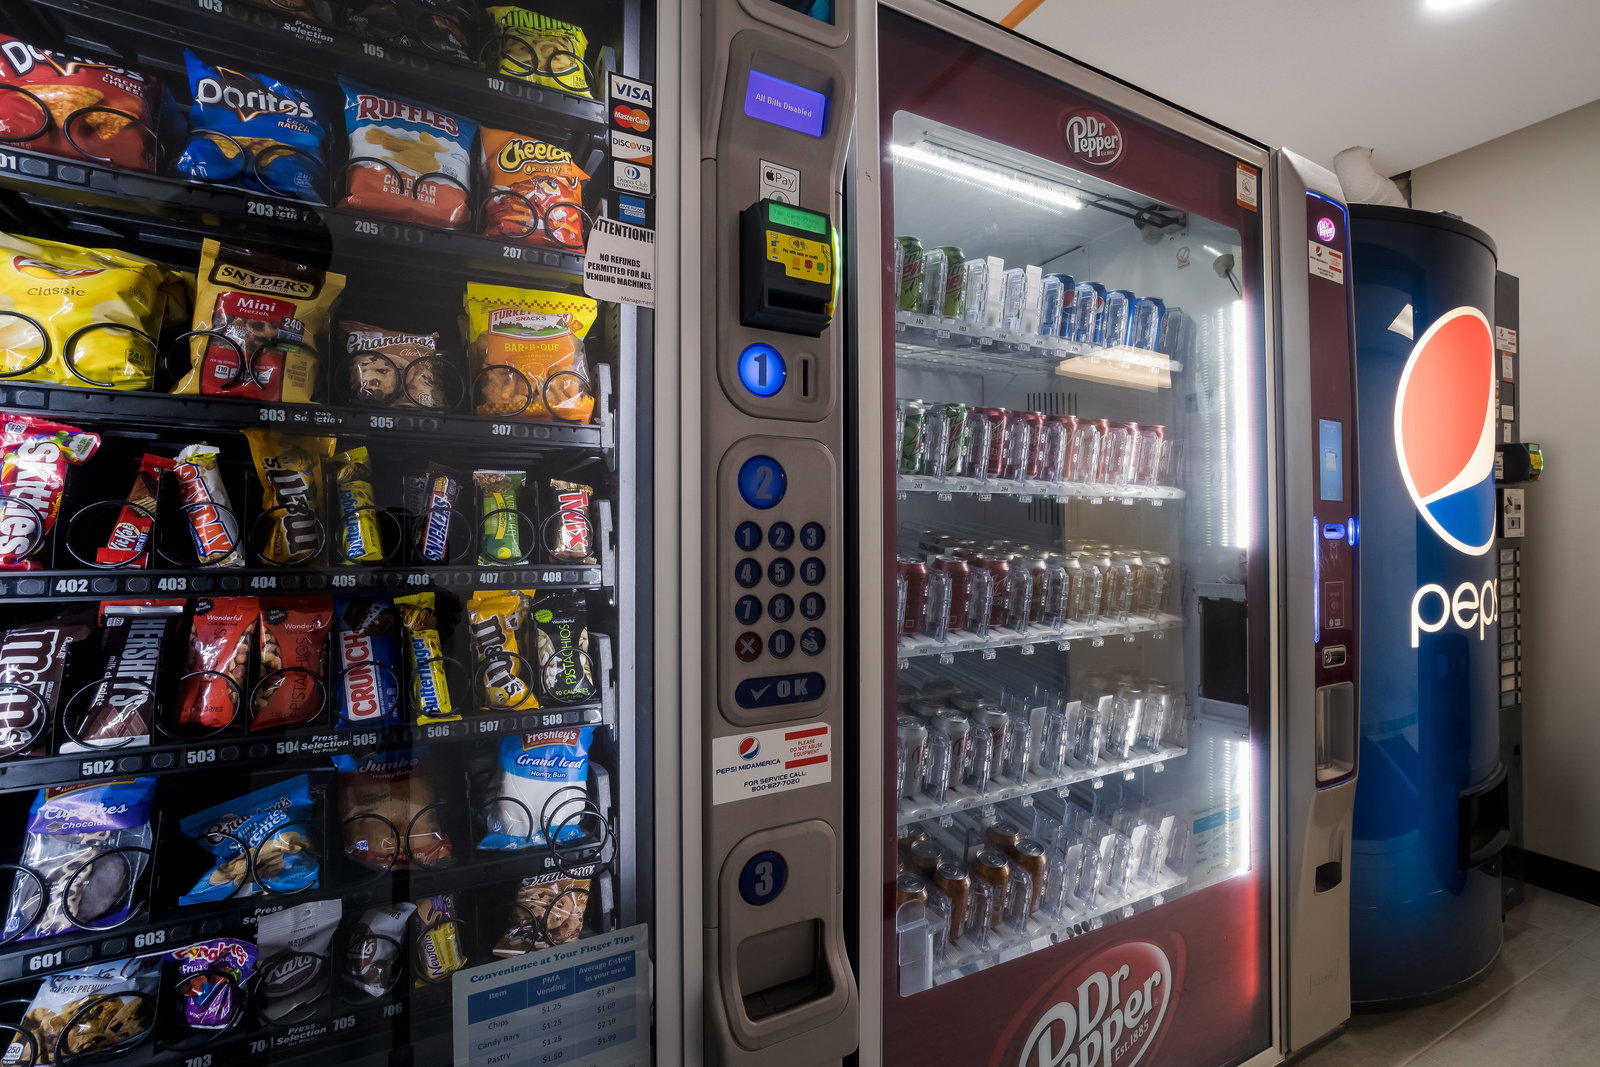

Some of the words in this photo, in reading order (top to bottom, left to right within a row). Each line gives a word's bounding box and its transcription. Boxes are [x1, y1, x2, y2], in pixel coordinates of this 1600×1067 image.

[283, 22, 333, 42] Selection
[294, 20, 322, 33] Press
[305, 36, 322, 44] Price
[362, 42, 384, 58] 105
[487, 77, 505, 91] 107
[614, 80, 651, 102] VISA
[197, 78, 314, 118] Doritos
[755, 92, 765, 102] All
[767, 96, 782, 108] Bills
[783, 101, 813, 118] Disabled
[358, 95, 459, 136] RUFFLES
[614, 111, 650, 126] MasterCard
[277, 121, 310, 133] RANCH
[1086, 116, 1106, 137] Dr
[1066, 116, 1118, 158] Pepper
[613, 138, 651, 153] DISCOVER
[617, 176, 634, 186] Diners
[635, 180, 648, 188] Club
[775, 172, 794, 189] Pay
[248, 201, 274, 217] 203
[619, 203, 644, 213] AMERICAN
[355, 221, 378, 235] 205
[592, 219, 654, 244] ATTENTION!!
[503, 246, 521, 259] 207
[599, 253, 610, 262] NO
[610, 255, 641, 268] REFUNDS
[588, 262, 626, 276] PERMITTED
[627, 270, 639, 278] FOR
[641, 272, 651, 281] ALL
[221, 266, 309, 294] SNYDER'S
[586, 272, 616, 284] VENDING
[617, 277, 653, 291] MACHINES.
[27, 286, 85, 297] Classic
[236, 297, 276, 312] Mini
[239, 308, 270, 317] Pretzels
[284, 318, 302, 331] 240
[129, 350, 145, 362] 240
[754, 353, 767, 387] 1
[259, 409, 286, 422] 303
[370, 416, 394, 429] 305
[492, 424, 511, 436] 307
[755, 466, 774, 499] 2
[558, 490, 589, 549] TWIX
[423, 494, 452, 561] SNICKERS
[743, 528, 750, 546] 1
[775, 528, 785, 546] 2
[806, 528, 817, 546] 3
[407, 573, 430, 585] 406
[480, 573, 499, 583] 407
[542, 572, 562, 582] 408
[741, 564, 752, 582] 4
[775, 563, 785, 582] 5
[806, 563, 817, 581] 6
[56, 579, 89, 593] 402
[157, 577, 187, 591] 403
[251, 576, 276, 588] 404
[332, 575, 356, 587] 405
[742, 600, 752, 619] 7
[775, 599, 785, 617] 8
[806, 598, 817, 616] 9
[206, 614, 243, 622] Wonderful
[775, 635, 786, 653] 0
[558, 624, 576, 685] PISTACHIOS
[344, 634, 378, 717] CRUNCH
[776, 678, 809, 698] OK
[480, 721, 499, 732] 507
[542, 714, 562, 726] 508
[427, 725, 450, 738] 506
[301, 739, 349, 751] Selection
[353, 733, 377, 746] 505
[187, 749, 216, 764] 503
[793, 749, 820, 758] EQUIPMENT
[82, 760, 114, 776] 502
[359, 757, 419, 773] Jumbo
[516, 754, 555, 769] Grand
[559, 757, 585, 769] Iced
[715, 766, 737, 776] PEPSI
[738, 758, 781, 772] MIDAMERICA
[530, 770, 551, 779] Honey
[743, 780, 759, 788] FOR
[760, 774, 788, 785] SERVICE
[788, 771, 807, 780] CALL:
[751, 779, 801, 793] 800-827-7020
[754, 861, 773, 896] 3
[254, 905, 283, 916] Press
[134, 930, 165, 948] 603
[29, 951, 62, 971] 601
[424, 934, 444, 976] Newtons
[470, 960, 538, 983] Convenience
[540, 957, 551, 966] at
[553, 949, 578, 963] Your
[580, 940, 612, 955] Finger
[613, 934, 634, 947] Tips
[578, 962, 607, 975] Average
[608, 955, 632, 967] C-store
[542, 974, 560, 985] PMA
[594, 971, 610, 982] your
[611, 966, 626, 976] area
[488, 989, 507, 1000] Item
[536, 983, 567, 997] Vending
[596, 985, 616, 997] $1.89
[541, 1002, 562, 1014] $1.25
[597, 1002, 616, 1014] $1.69
[1076, 963, 1130, 1041] Dr
[288, 1023, 316, 1035] Press
[332, 1015, 356, 1031] 705
[488, 1019, 509, 1030] Chips
[541, 1019, 562, 1031] $1.25
[597, 1018, 616, 1030] $2.19
[276, 1026, 327, 1046] Selection
[477, 1039, 502, 1051] Candy
[503, 1032, 520, 1043] Bars
[542, 1035, 563, 1047] $1.25
[597, 1033, 617, 1045] $1.99
[487, 1052, 511, 1065] Pastry
[542, 1051, 563, 1064] $1.50
